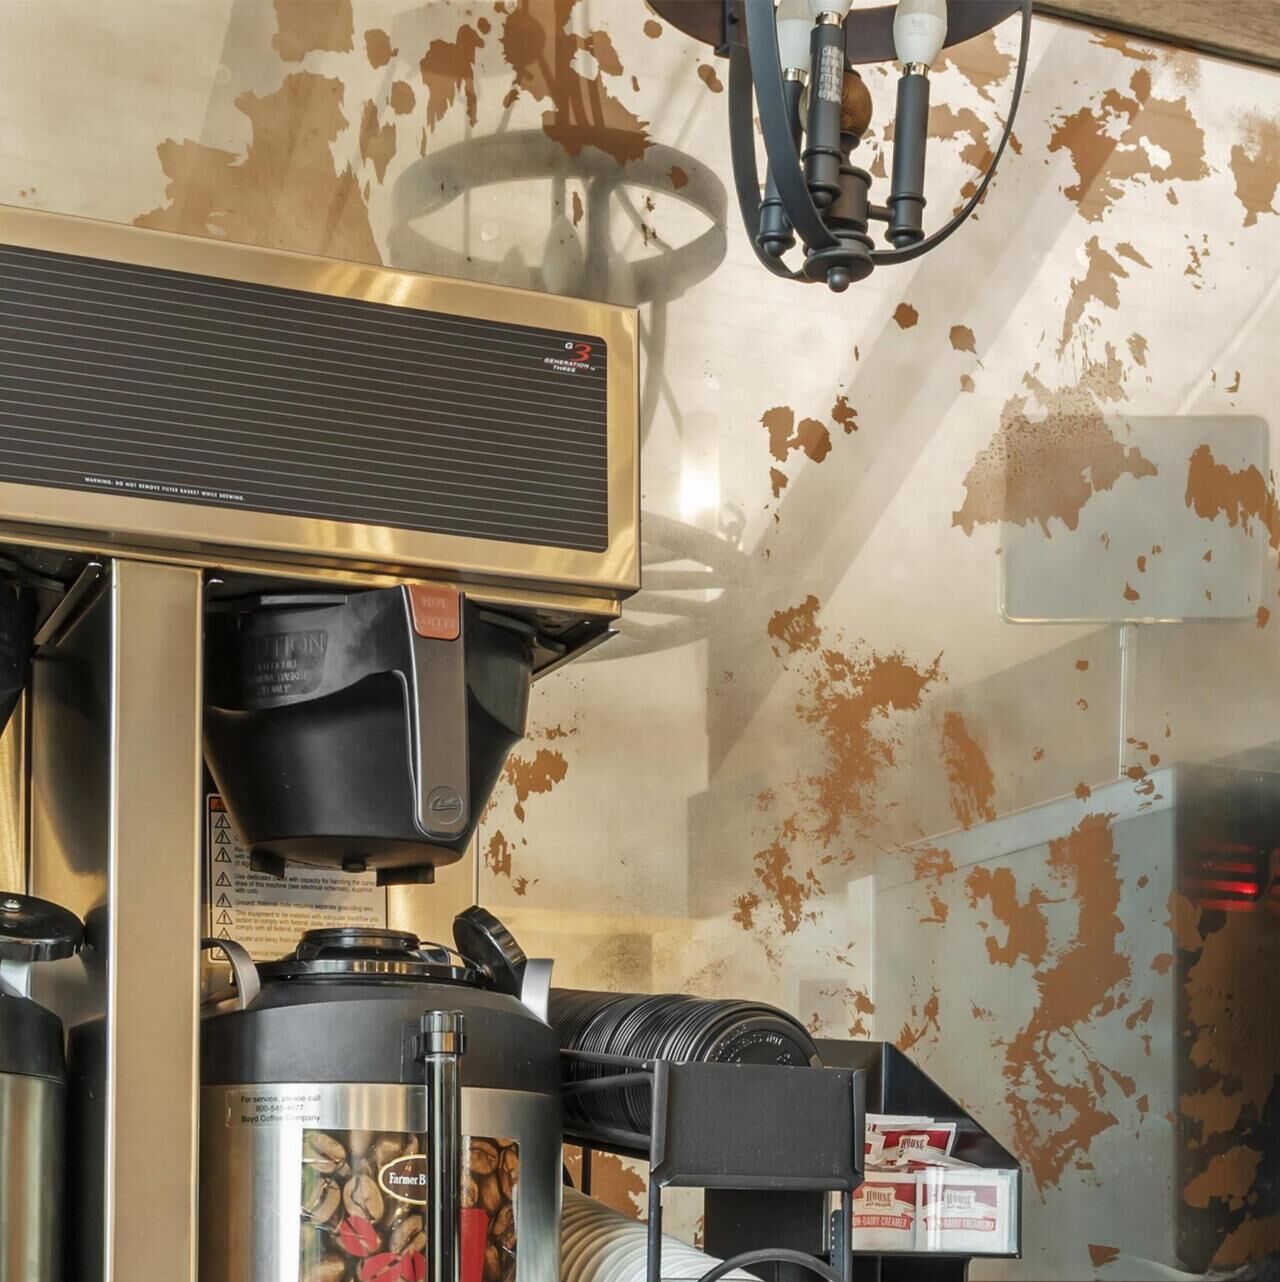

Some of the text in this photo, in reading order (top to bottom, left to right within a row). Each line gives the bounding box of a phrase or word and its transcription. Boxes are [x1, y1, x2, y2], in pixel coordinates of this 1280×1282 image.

[544, 357, 589, 369] GENERATION
[553, 365, 576, 373] THREE
[389, 1173, 418, 1186] Farmer
[853, 1216, 907, 1227] ON-DAIRY CREAMER
